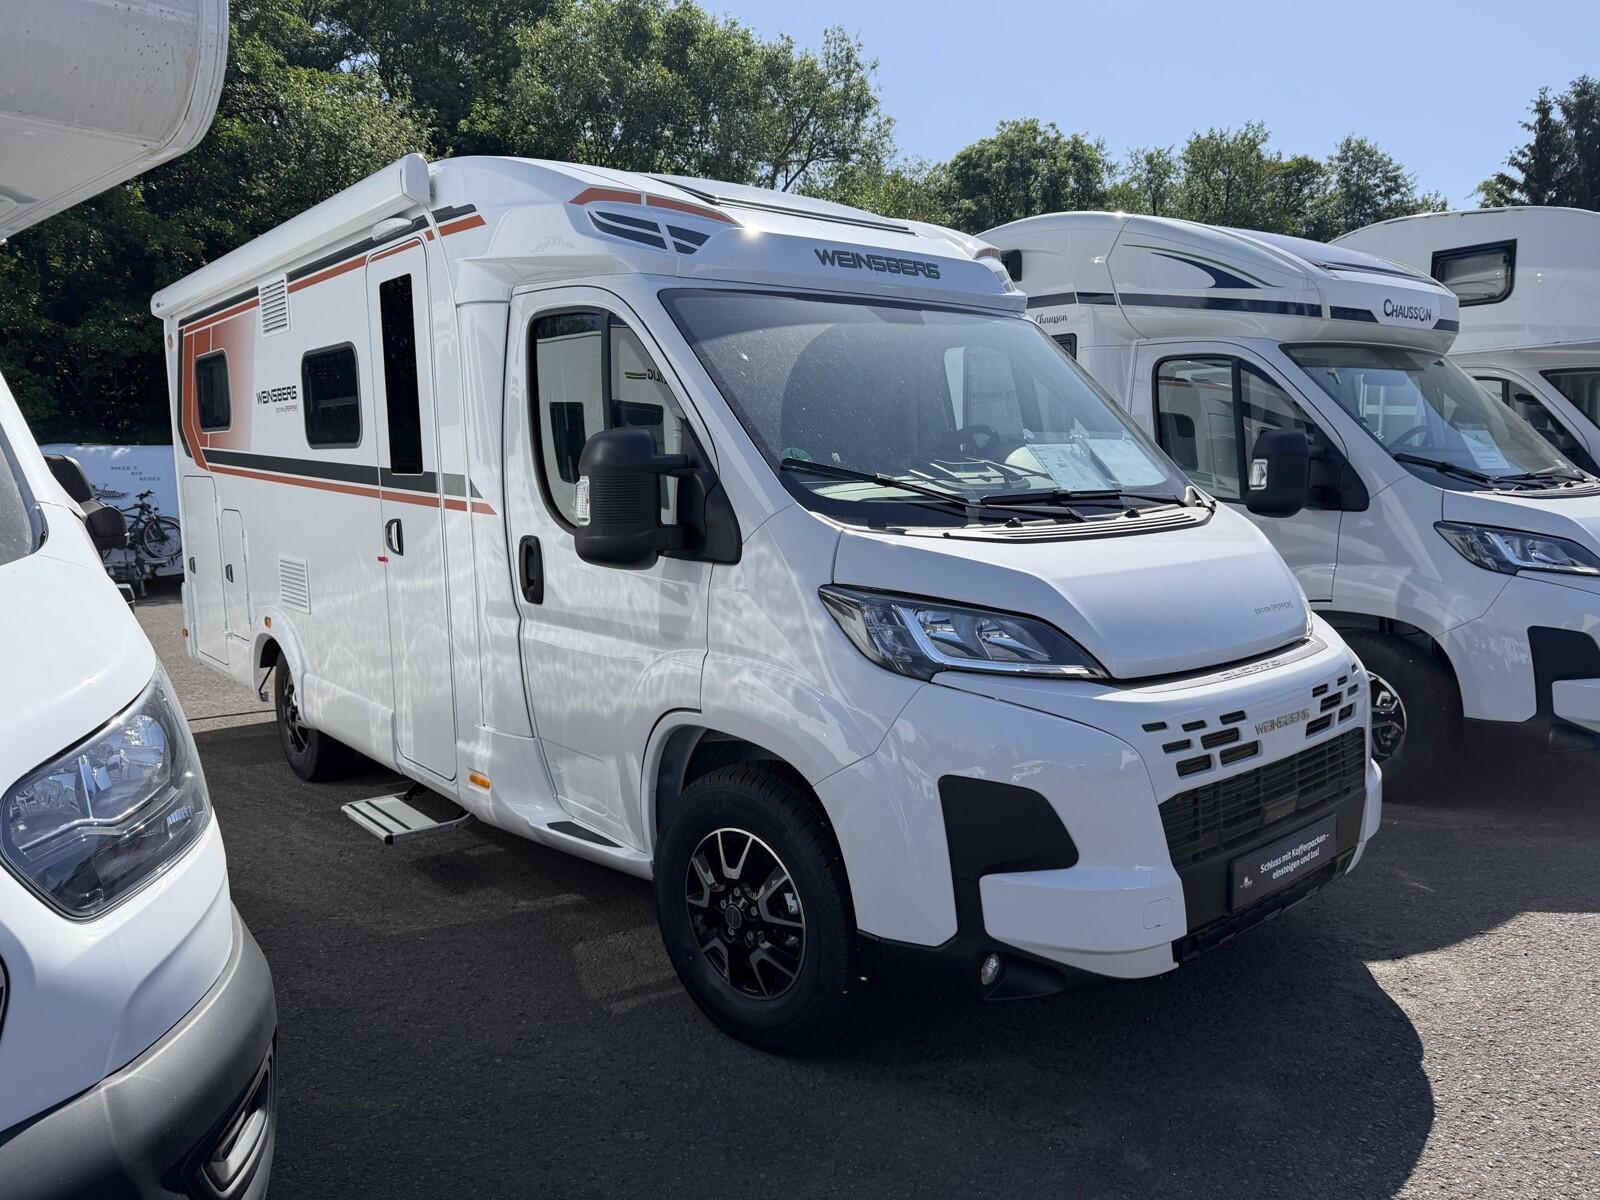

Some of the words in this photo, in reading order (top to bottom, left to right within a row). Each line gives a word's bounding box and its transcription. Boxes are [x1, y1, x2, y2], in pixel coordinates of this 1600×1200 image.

[814, 248, 941, 280] WEINSBERG
[1035, 312, 1068, 325] Chausson
[1383, 298, 1432, 321] CHAUSSON
[256, 385, 297, 405] WEINSBERG
[1219, 660, 1281, 680] DUCATO
[1254, 708, 1311, 736] WEINSBERG
[1260, 856, 1282, 873] Schluss
[1281, 851, 1292, 862] mit
[1291, 834, 1326, 858] Kofferpacken
[1272, 859, 1300, 879] einsteigen
[1300, 852, 1311, 865] und
[1310, 847, 1320, 859] los!
